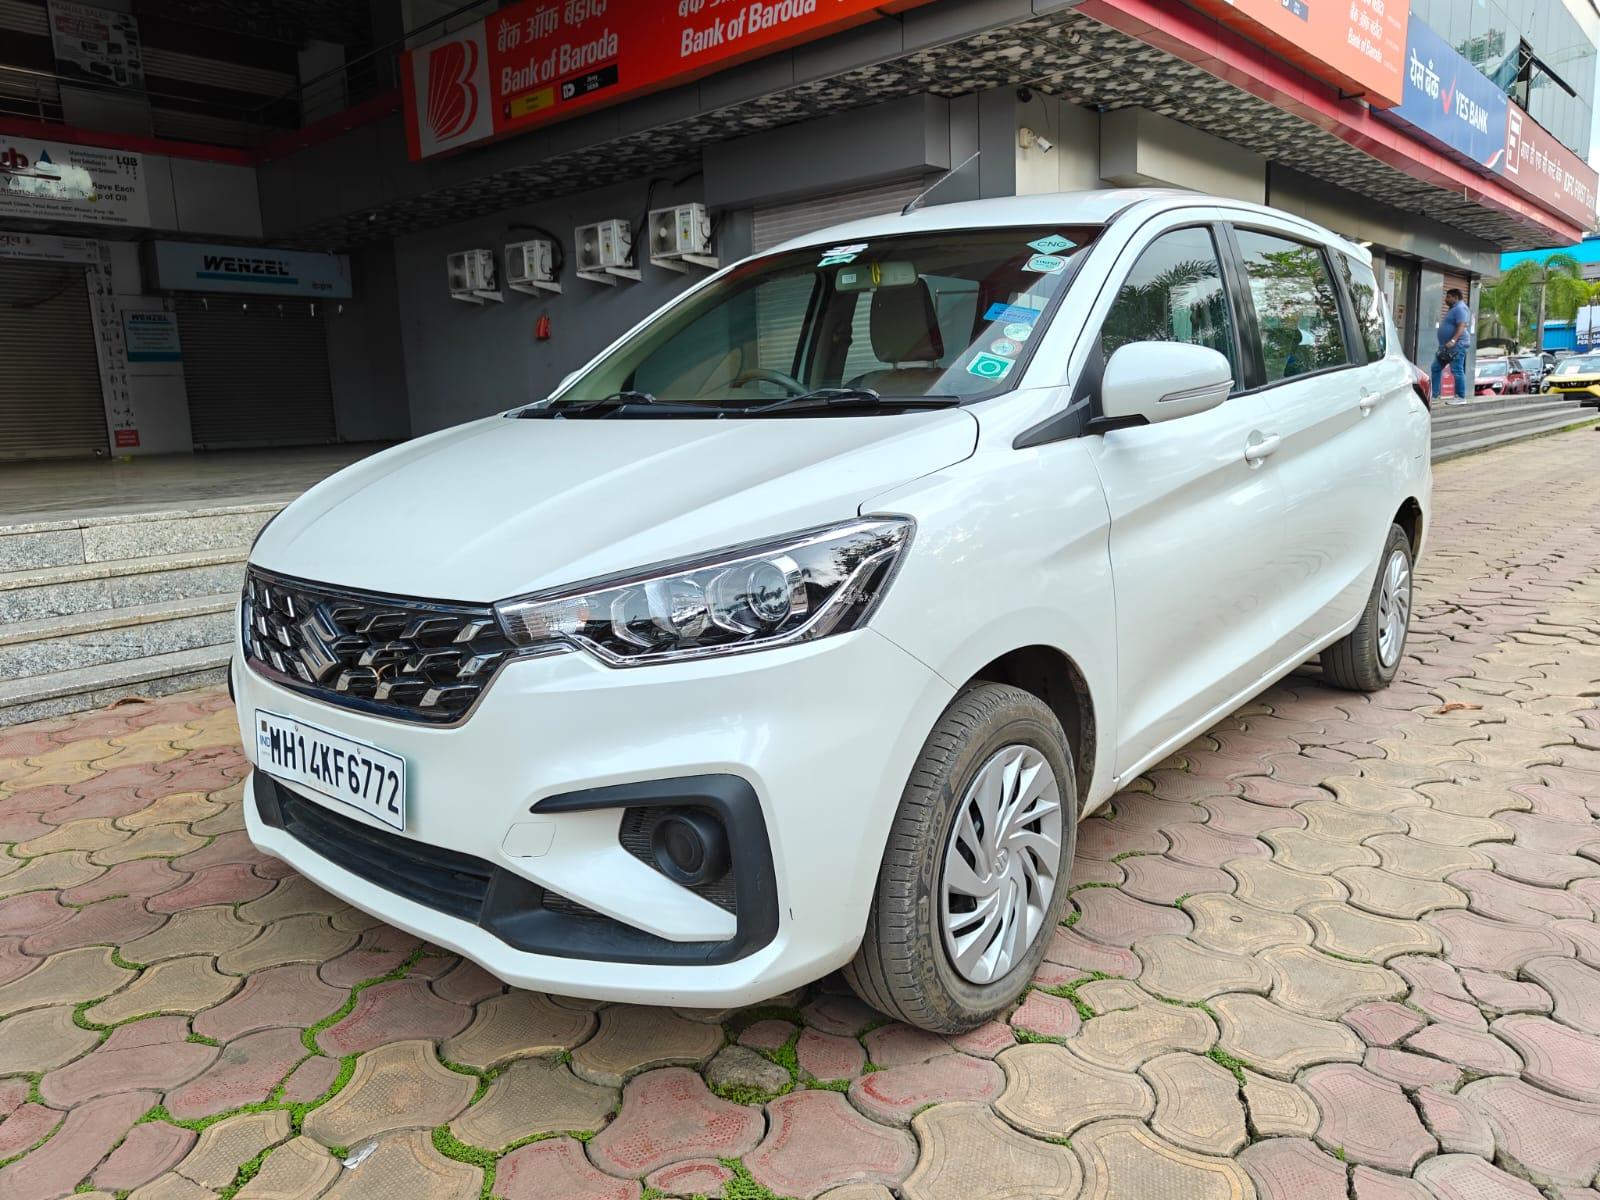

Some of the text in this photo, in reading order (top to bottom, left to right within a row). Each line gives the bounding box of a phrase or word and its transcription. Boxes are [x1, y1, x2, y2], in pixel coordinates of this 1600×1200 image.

[680, 17, 725, 58] Bank
[727, 8, 746, 41] of
[501, 57, 539, 96] Bank
[541, 47, 558, 81] of
[559, 27, 618, 75] Baroda
[1455, 89, 1489, 135] YES BANK
[203, 255, 289, 276] WENZEL
[269, 726, 399, 815] MH14KF6772
